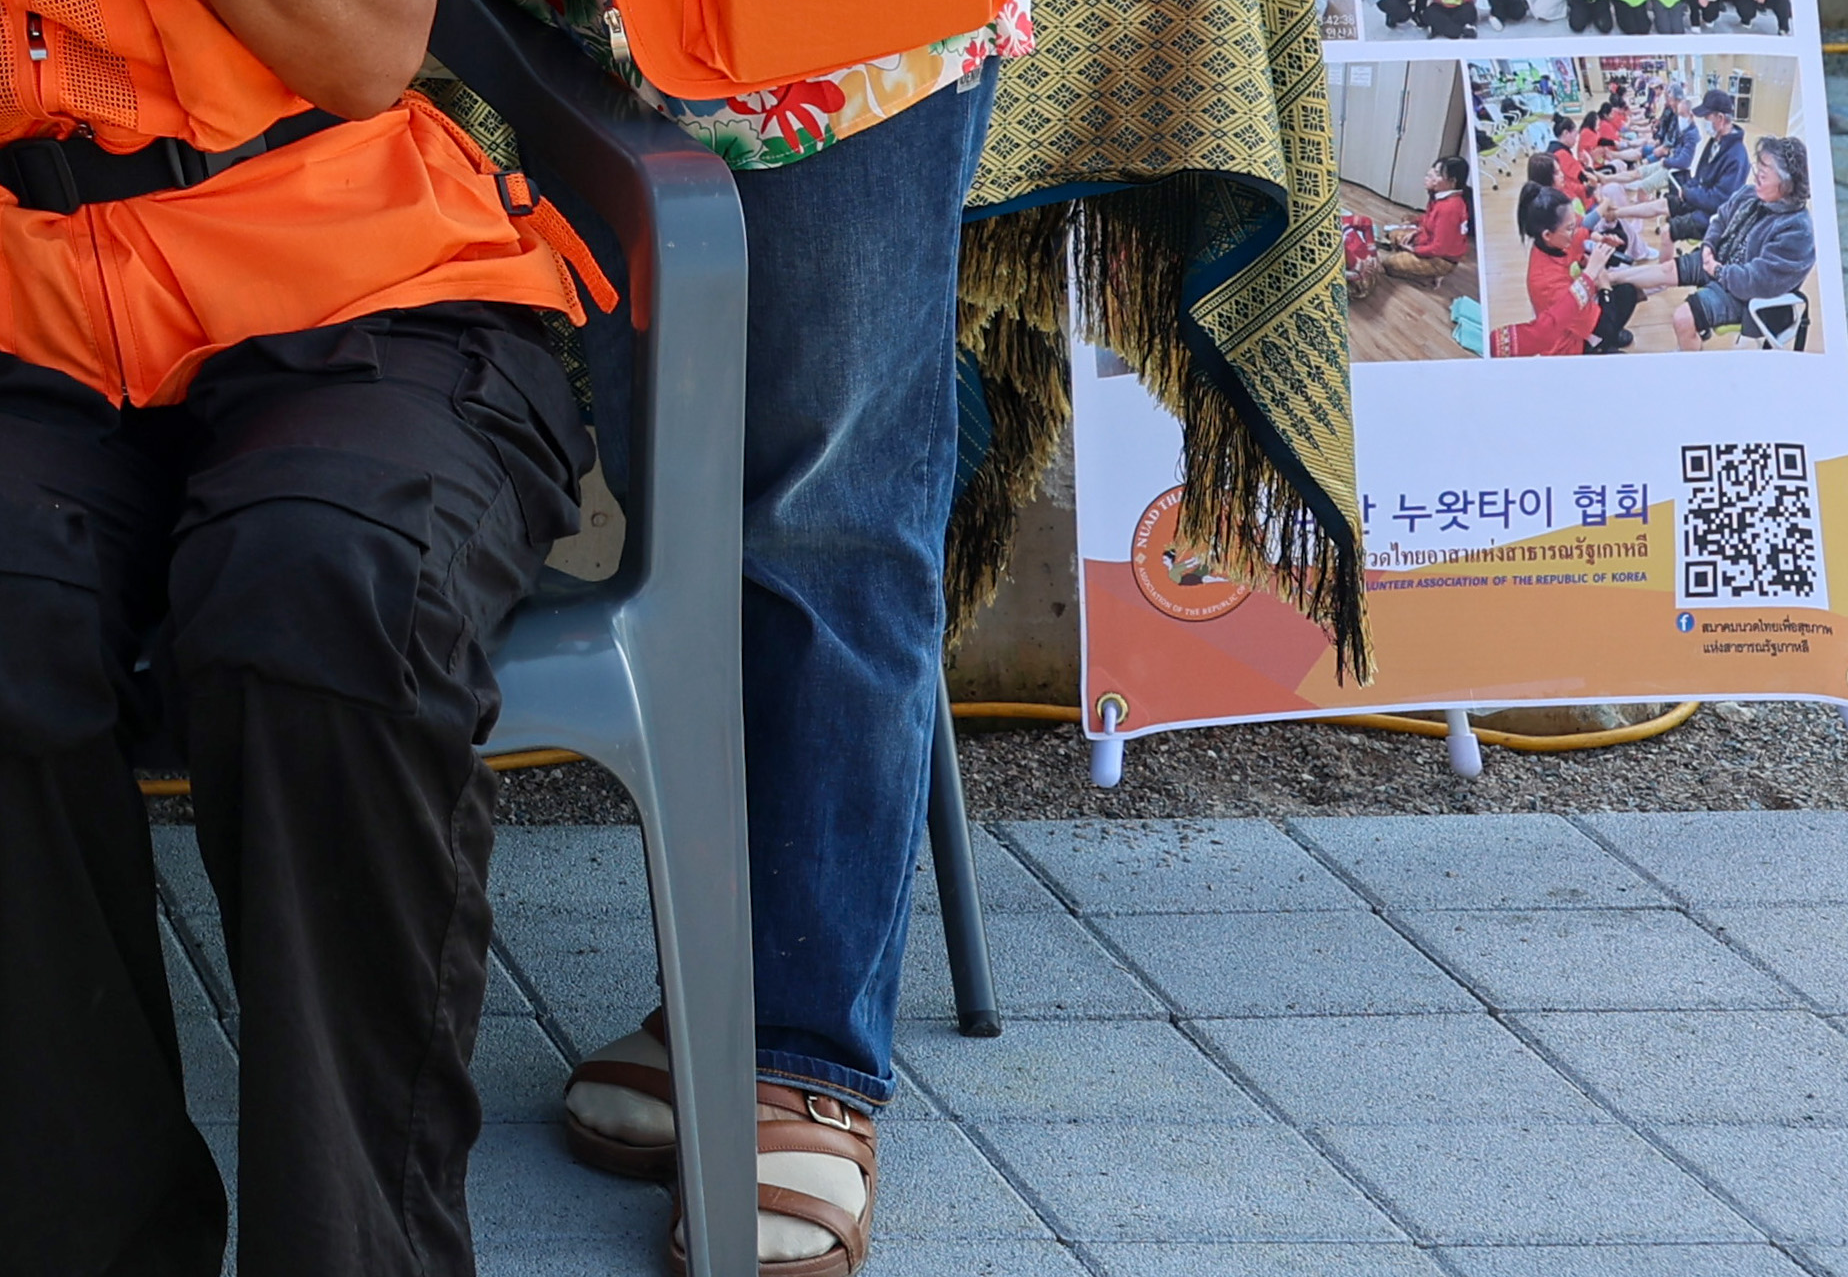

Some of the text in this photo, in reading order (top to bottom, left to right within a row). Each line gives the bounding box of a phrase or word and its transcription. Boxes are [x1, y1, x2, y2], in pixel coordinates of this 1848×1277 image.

[1392, 485, 1553, 534] 누왓타이
[1573, 482, 1650, 527] 협회
[1137, 509, 1161, 548] NUAD
[1416, 576, 1488, 589] ASSOCIATION
[1492, 576, 1507, 586] OF
[1512, 575, 1534, 586] THE
[1536, 574, 1588, 585] REPUBLIC
[1593, 573, 1607, 583] OF
[1612, 572, 1648, 583] KOREA
